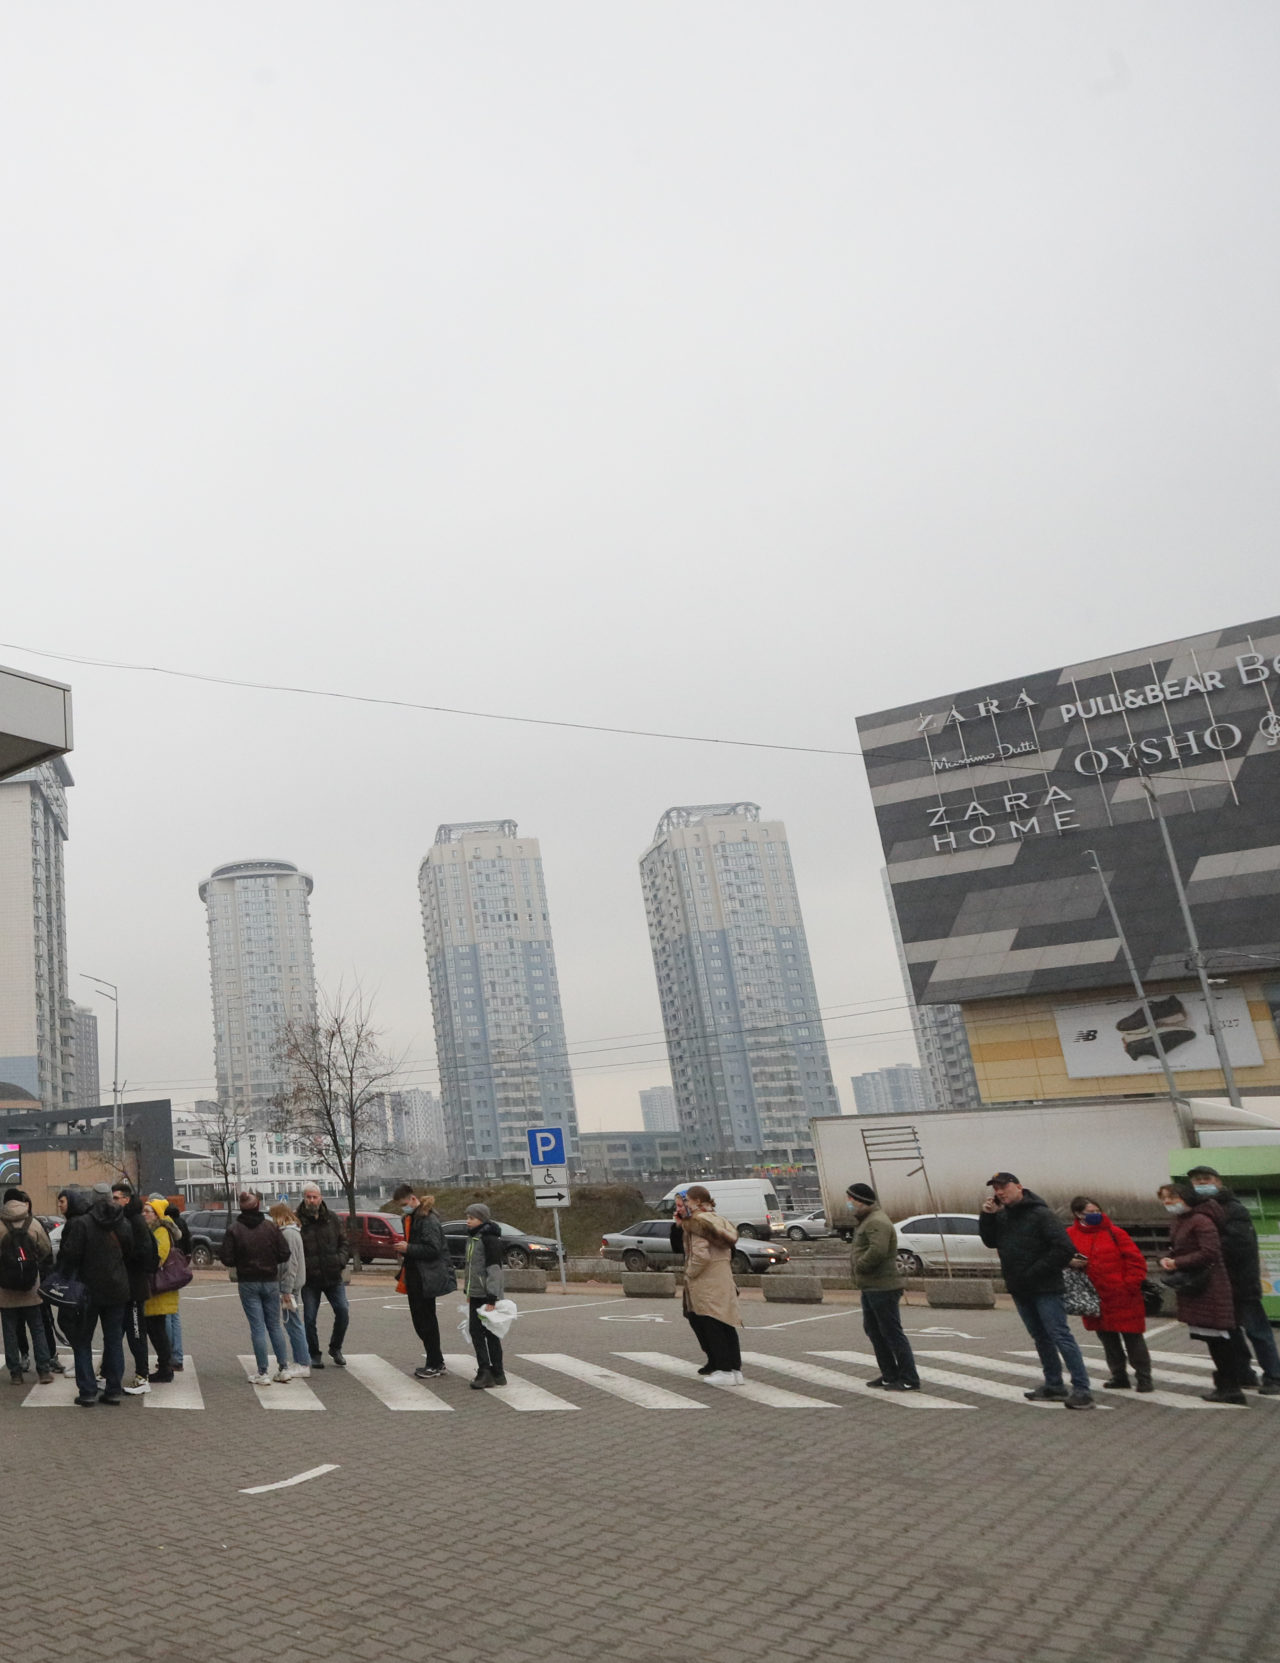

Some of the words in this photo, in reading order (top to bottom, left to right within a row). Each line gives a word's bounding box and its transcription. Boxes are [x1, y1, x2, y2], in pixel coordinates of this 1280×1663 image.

[918, 692, 1039, 731] ZARA
[1059, 671, 1225, 723] PULL&BEAR
[932, 752, 995, 773] Massimo
[997, 741, 1039, 758] Dutti
[1074, 723, 1242, 775] OYSHO
[926, 786, 1072, 827] ZARA
[932, 809, 1081, 851] HOME
[535, 1132, 556, 1162] P
